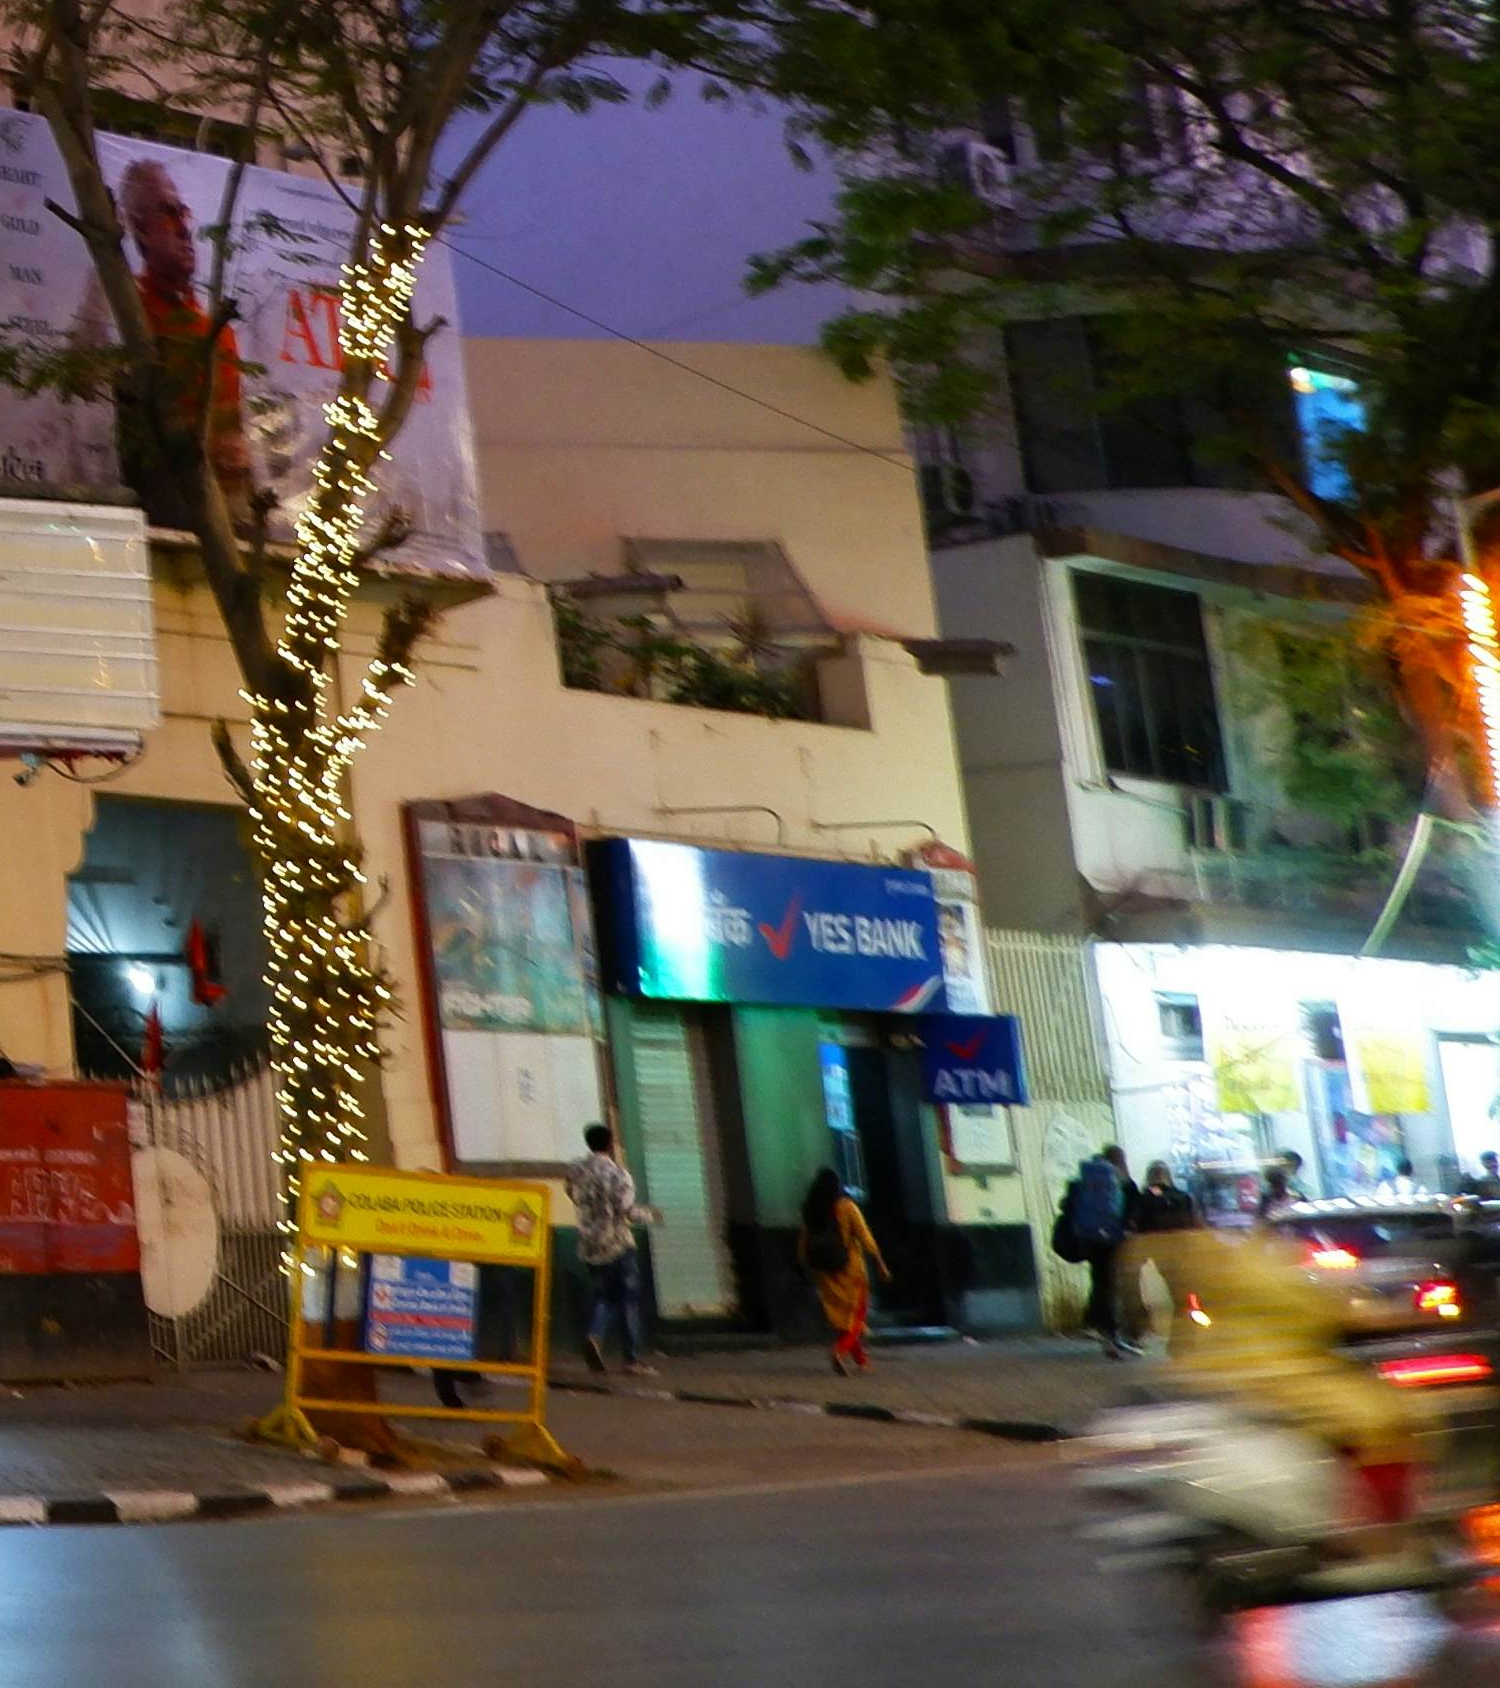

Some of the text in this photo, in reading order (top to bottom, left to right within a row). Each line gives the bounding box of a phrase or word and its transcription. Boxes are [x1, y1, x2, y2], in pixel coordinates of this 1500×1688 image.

[803, 911, 928, 962] YES BANK
[932, 1067, 1014, 1099] ATM
